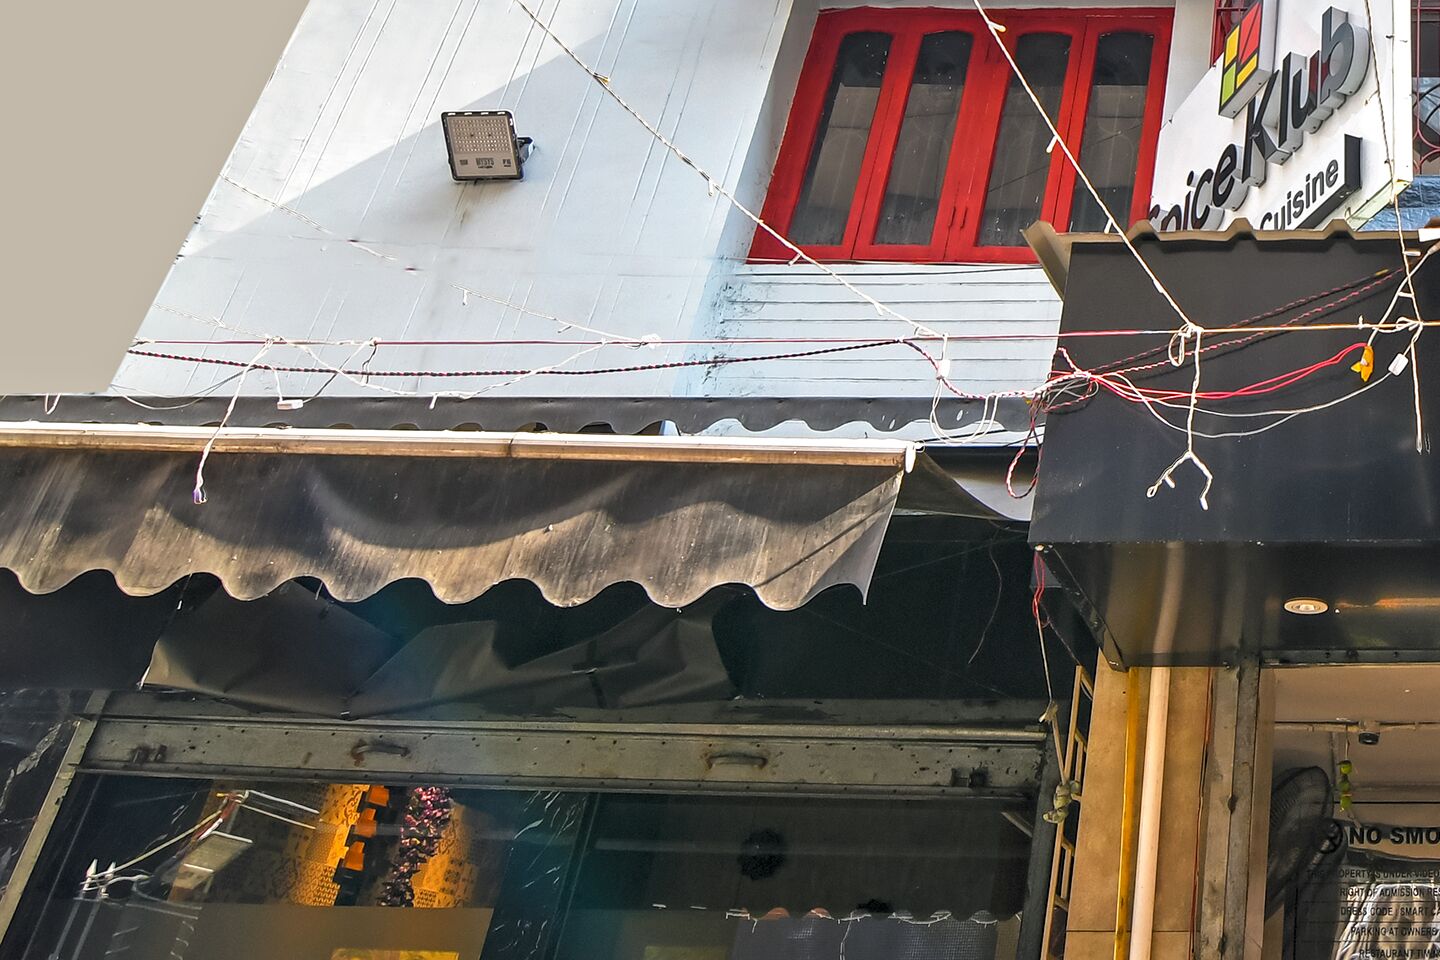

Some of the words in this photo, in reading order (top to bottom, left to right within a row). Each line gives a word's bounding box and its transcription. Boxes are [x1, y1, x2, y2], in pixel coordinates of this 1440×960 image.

[1349, 826, 1382, 844] NO
[1337, 868, 1371, 879] OPERTY
[1383, 869, 1414, 879] UNDER
[1415, 869, 1440, 879] VIDEO
[1340, 887, 1364, 897] RIGHT
[1379, 887, 1425, 897] ADMISSION
[1340, 906, 1367, 916] DRESS
[1370, 906, 1393, 916] CODE
[1399, 906, 1428, 916] SMART
[1350, 926, 1386, 936] PARKING
[1388, 926, 1399, 936] AT
[1359, 948, 1417, 959] RESTAURANT
